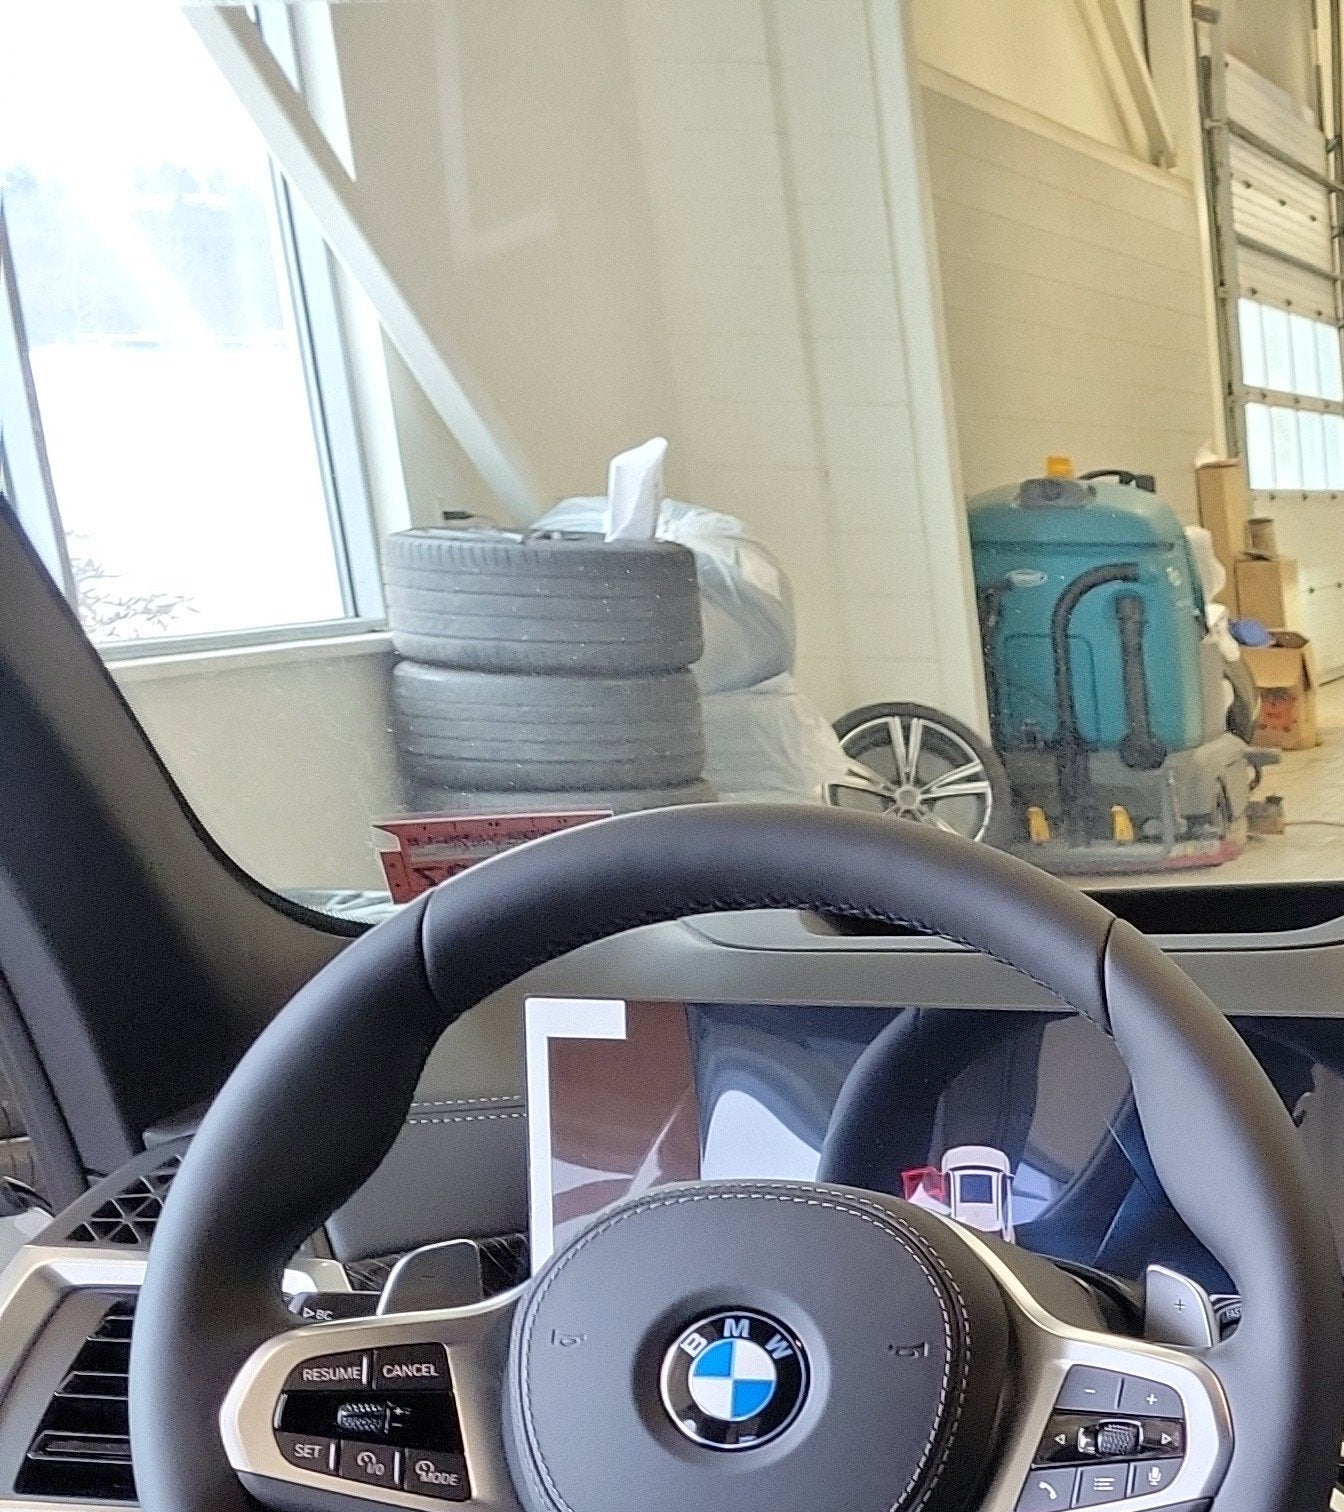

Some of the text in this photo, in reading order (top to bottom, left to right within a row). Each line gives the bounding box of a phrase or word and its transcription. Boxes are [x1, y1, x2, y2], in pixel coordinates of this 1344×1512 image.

[679, 1318, 794, 1360] BMW
[302, 1366, 361, 1381] RESUME
[382, 1364, 440, 1378] CANCEL
[294, 1444, 323, 1458] SET
[419, 1472, 460, 1487] MODE
